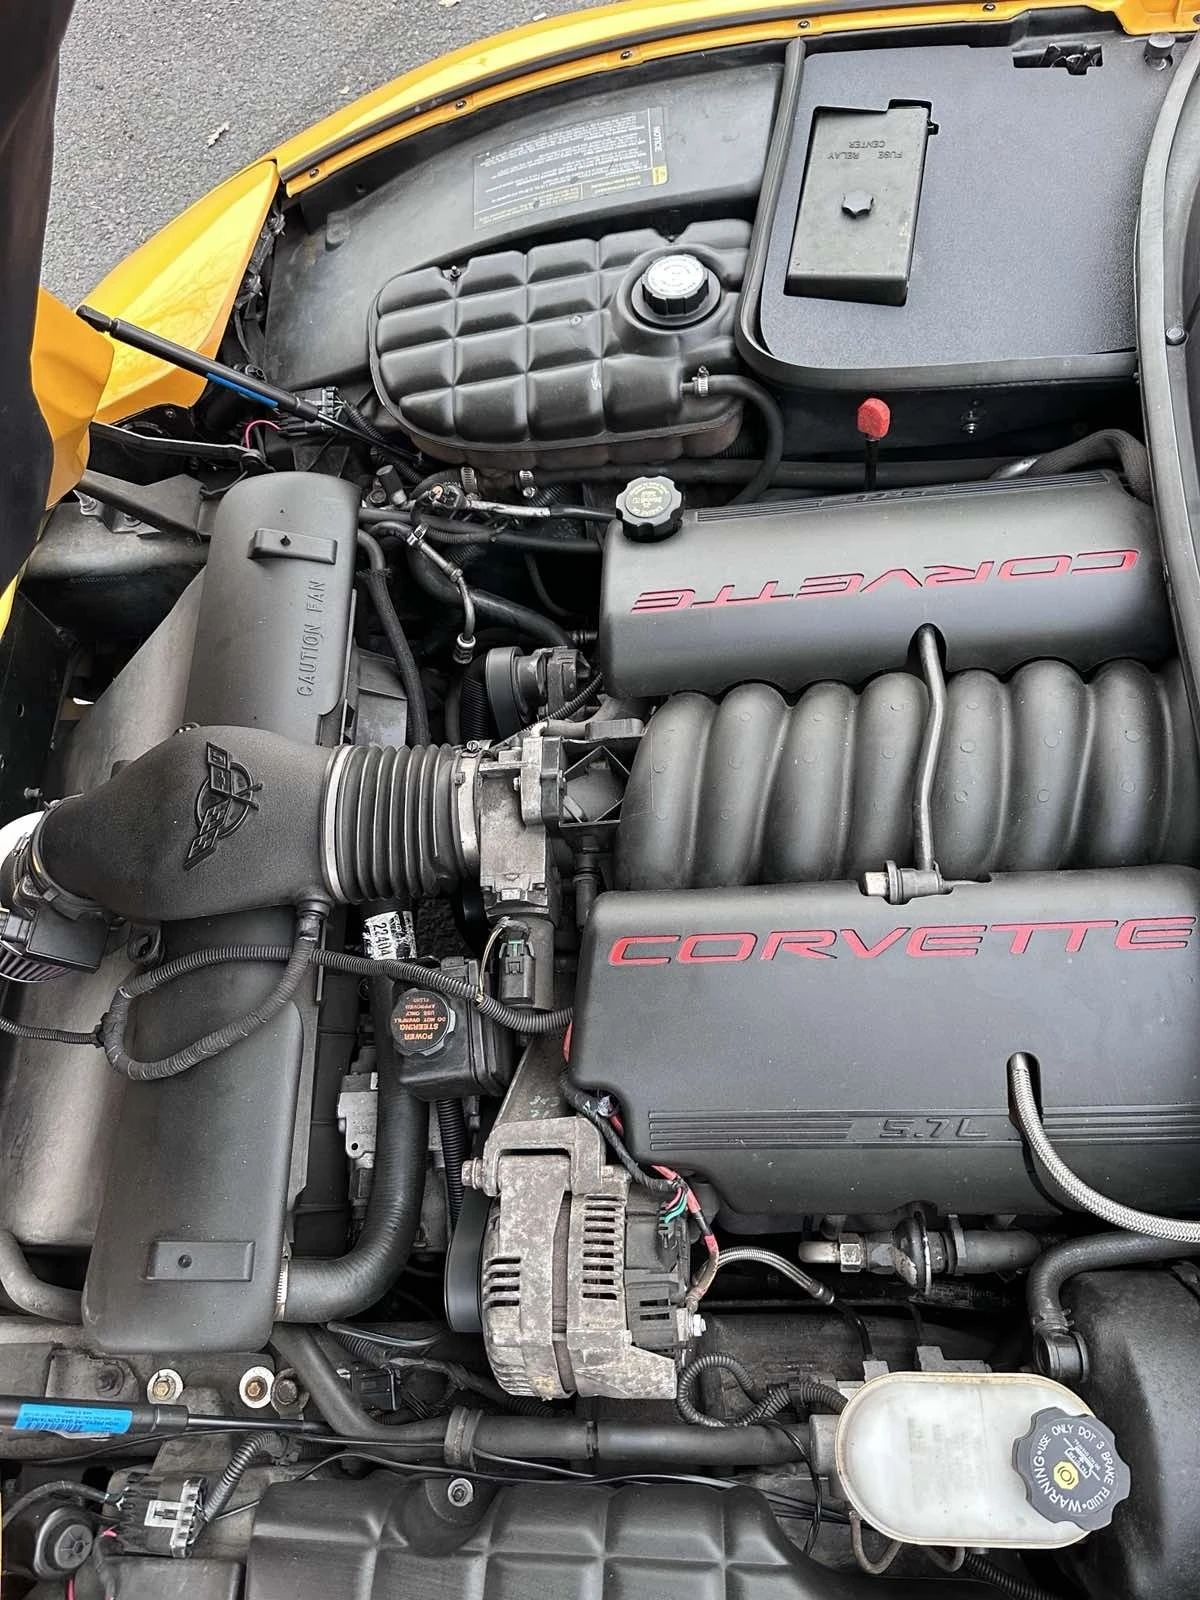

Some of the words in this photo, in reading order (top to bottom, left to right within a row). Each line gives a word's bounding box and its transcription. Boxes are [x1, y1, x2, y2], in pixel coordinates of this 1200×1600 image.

[653, 126, 663, 153] NOTICE
[848, 140, 886, 149] CENTER
[827, 151, 860, 160] RELAY
[877, 150, 903, 159] FUSE
[630, 549, 1139, 614] CORVETTE
[306, 581, 326, 613] FAN
[296, 624, 321, 697] CAUTION
[608, 916, 1197, 967] CORVETTE
[399, 1023, 439, 1031] STEERING
[404, 1032, 433, 1040] POWER
[880, 1118, 988, 1138] 5.7L
[1051, 1423, 1074, 1437] ONLY
[1078, 1426, 1096, 1442] DOT
[1039, 1433, 1052, 1452] USE
[1096, 1441, 1105, 1450] 3
[1100, 1451, 1117, 1486] BRAKE
[1033, 1455, 1082, 1513] WARNING
[1086, 1486, 1111, 1511] FLUID
